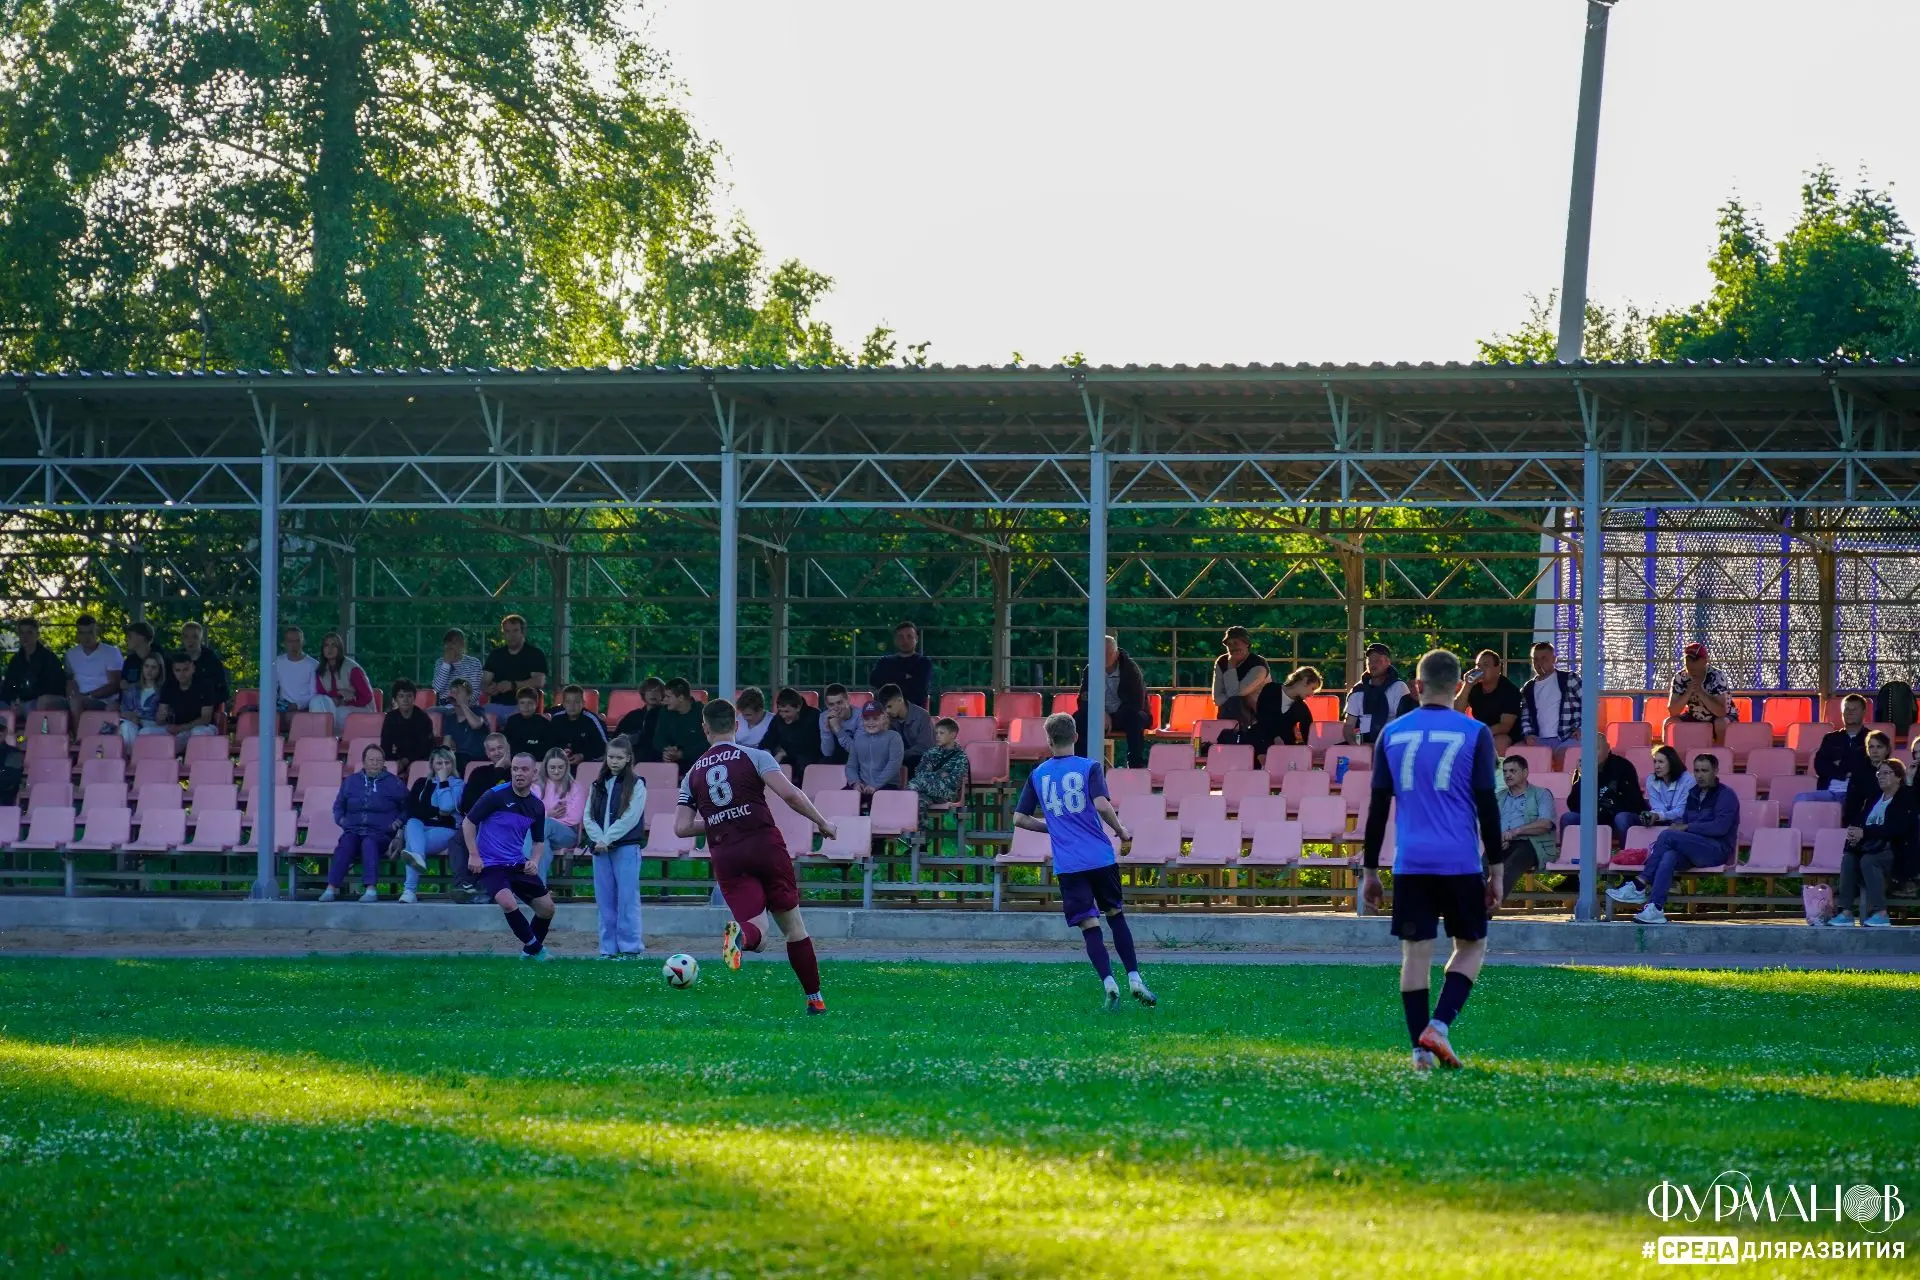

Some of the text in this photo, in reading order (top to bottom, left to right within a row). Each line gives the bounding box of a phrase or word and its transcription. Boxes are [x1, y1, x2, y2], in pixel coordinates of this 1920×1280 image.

[695, 749, 741, 770] ВОСХОД
[1388, 730, 1466, 791] 77
[705, 764, 733, 807] 8
[1041, 771, 1087, 817] 48
[707, 804, 752, 826] МИРТЕКС
